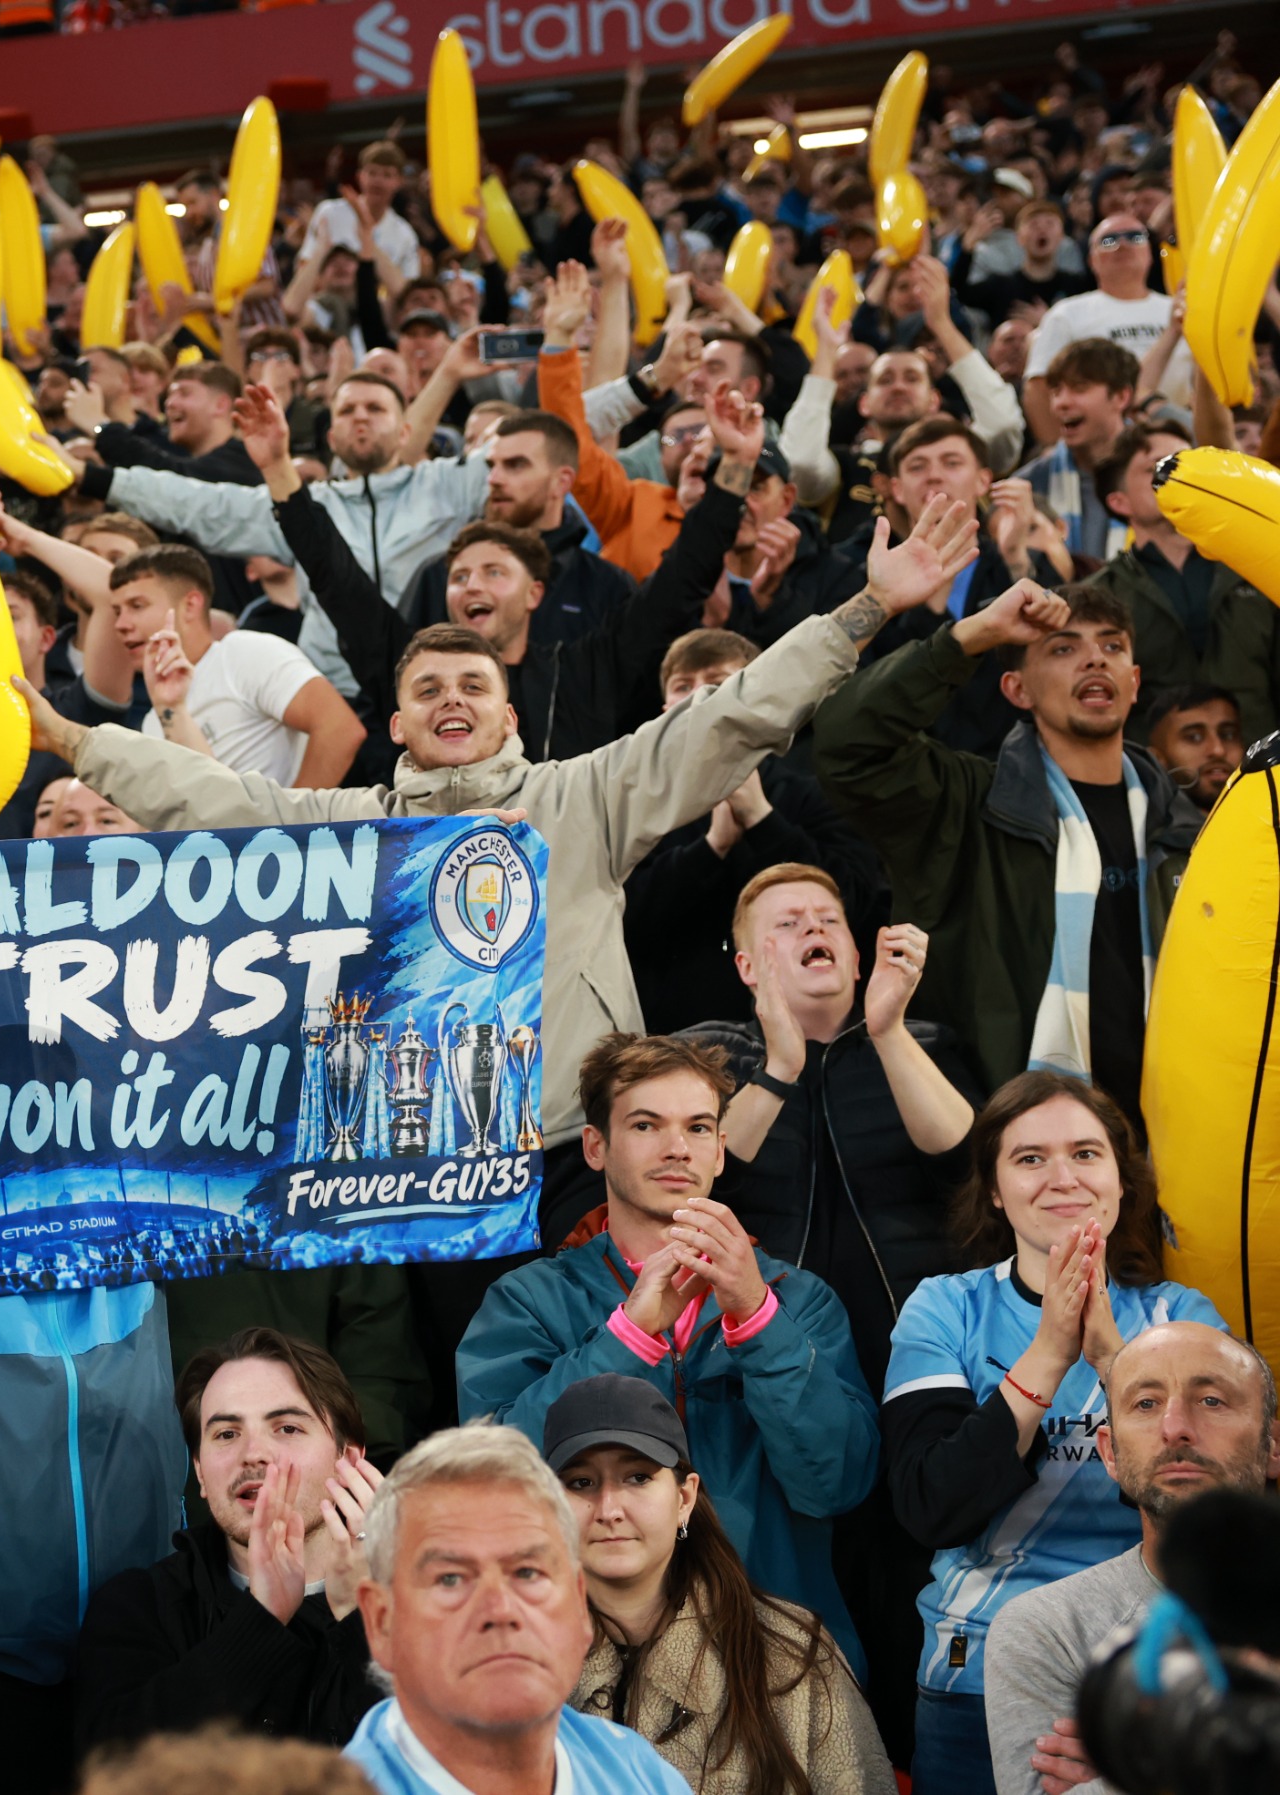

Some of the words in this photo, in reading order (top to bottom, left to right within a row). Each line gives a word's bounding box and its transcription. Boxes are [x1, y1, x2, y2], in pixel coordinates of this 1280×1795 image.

[110, 1050, 176, 1149] it
[287, 1154, 531, 1216] Forever-GUY35
[1, 1222, 63, 1240] ETIHAD
[69, 1216, 117, 1230] STADIUM
